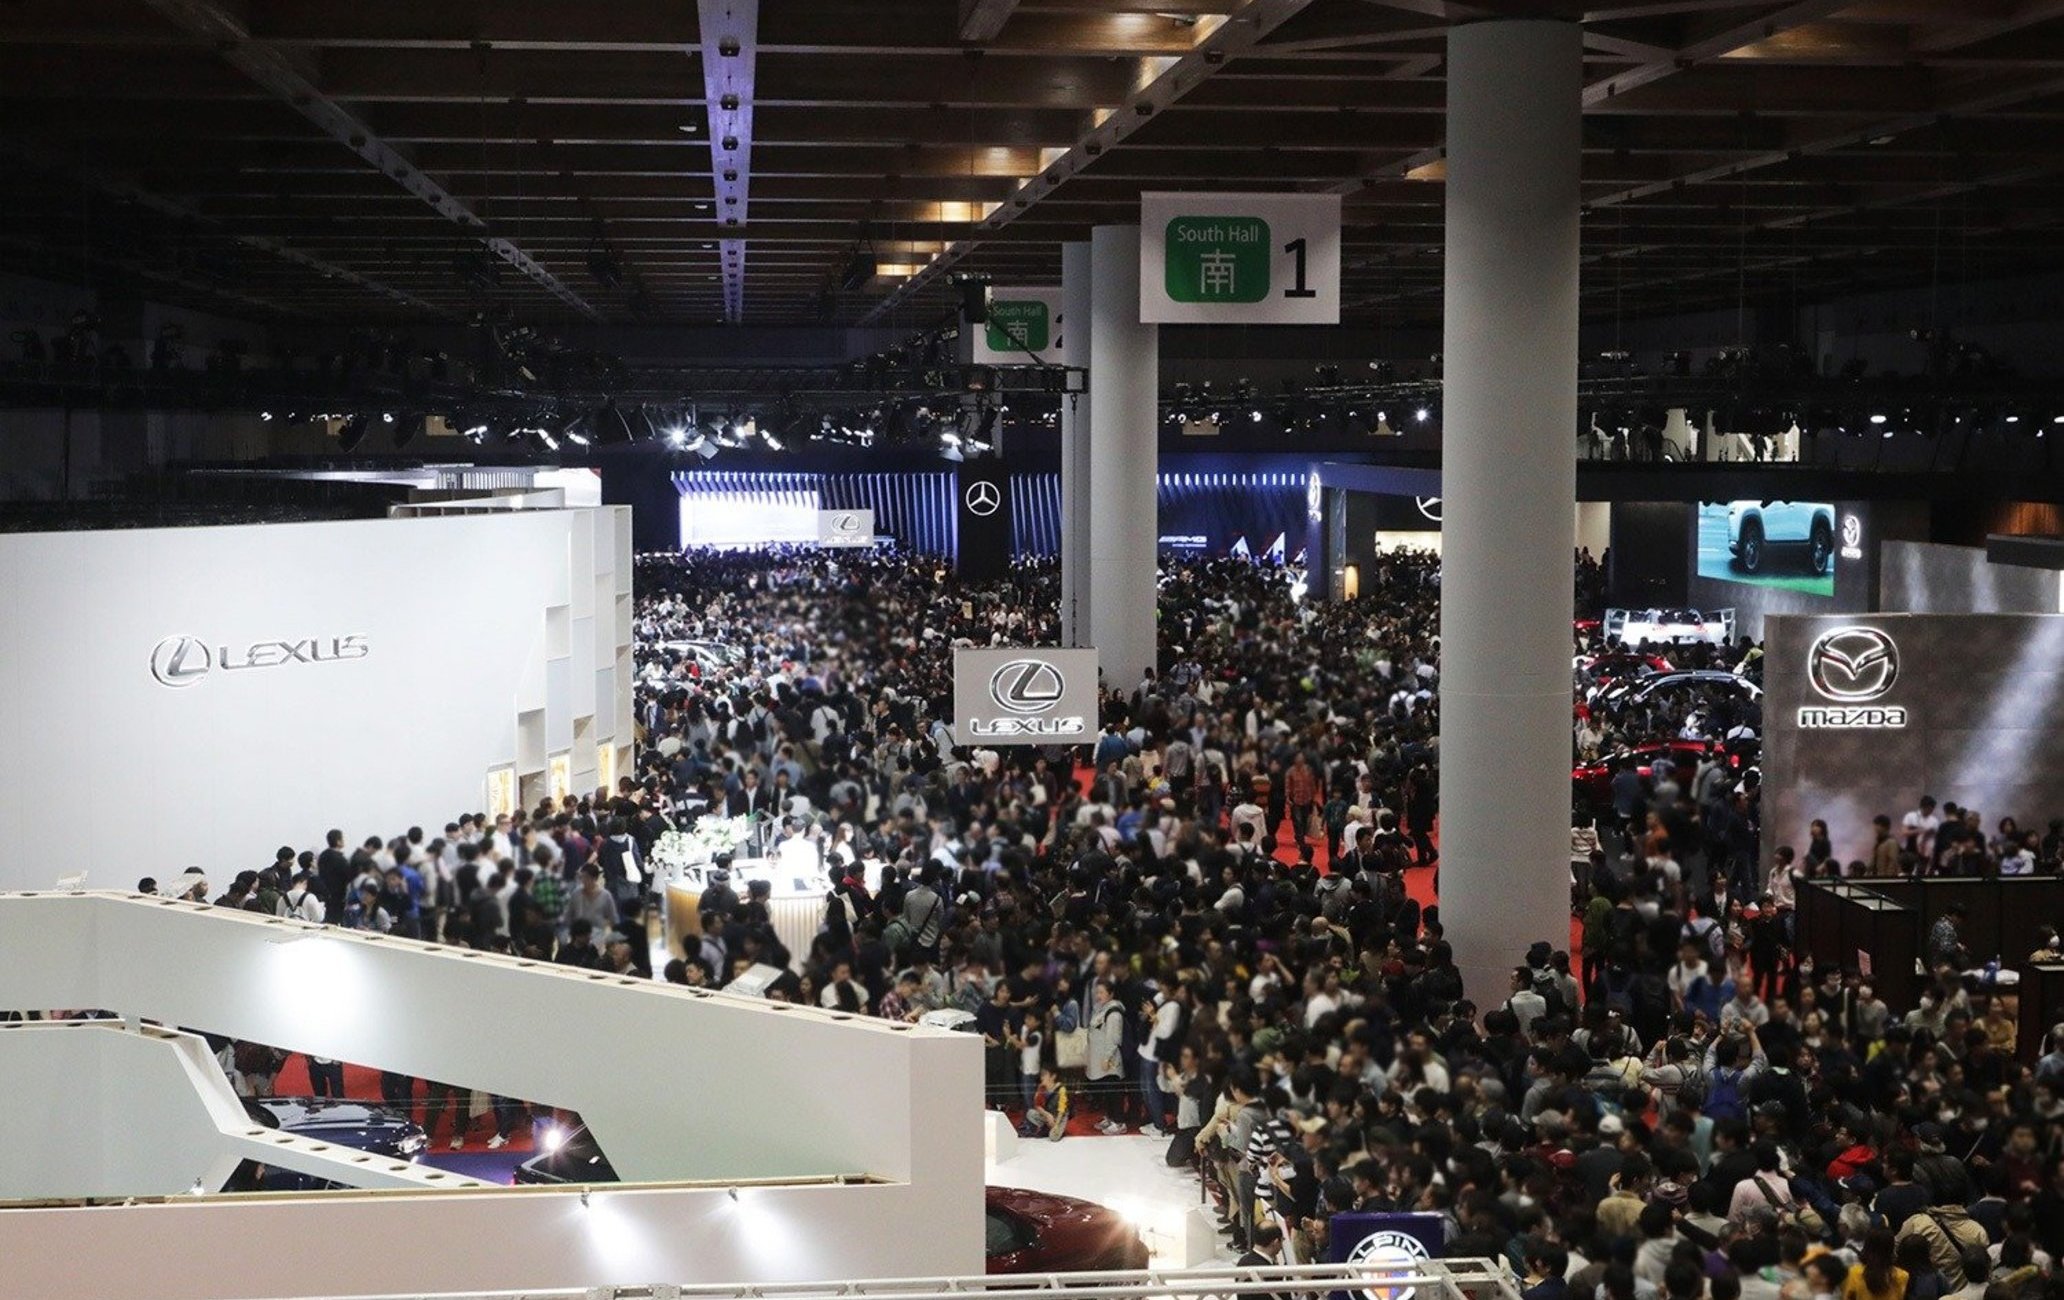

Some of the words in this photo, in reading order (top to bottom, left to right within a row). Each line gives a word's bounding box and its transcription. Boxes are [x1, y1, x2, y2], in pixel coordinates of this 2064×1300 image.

[1178, 225, 1224, 242] South
[1229, 225, 1259, 242] Hall
[1201, 249, 1236, 294] 南
[1284, 238, 1316, 298] 1
[1024, 304, 1043, 317] Hall
[1007, 320, 1028, 348] 南
[220, 635, 368, 670] LEXUS
[970, 716, 1086, 735] LEXUS
